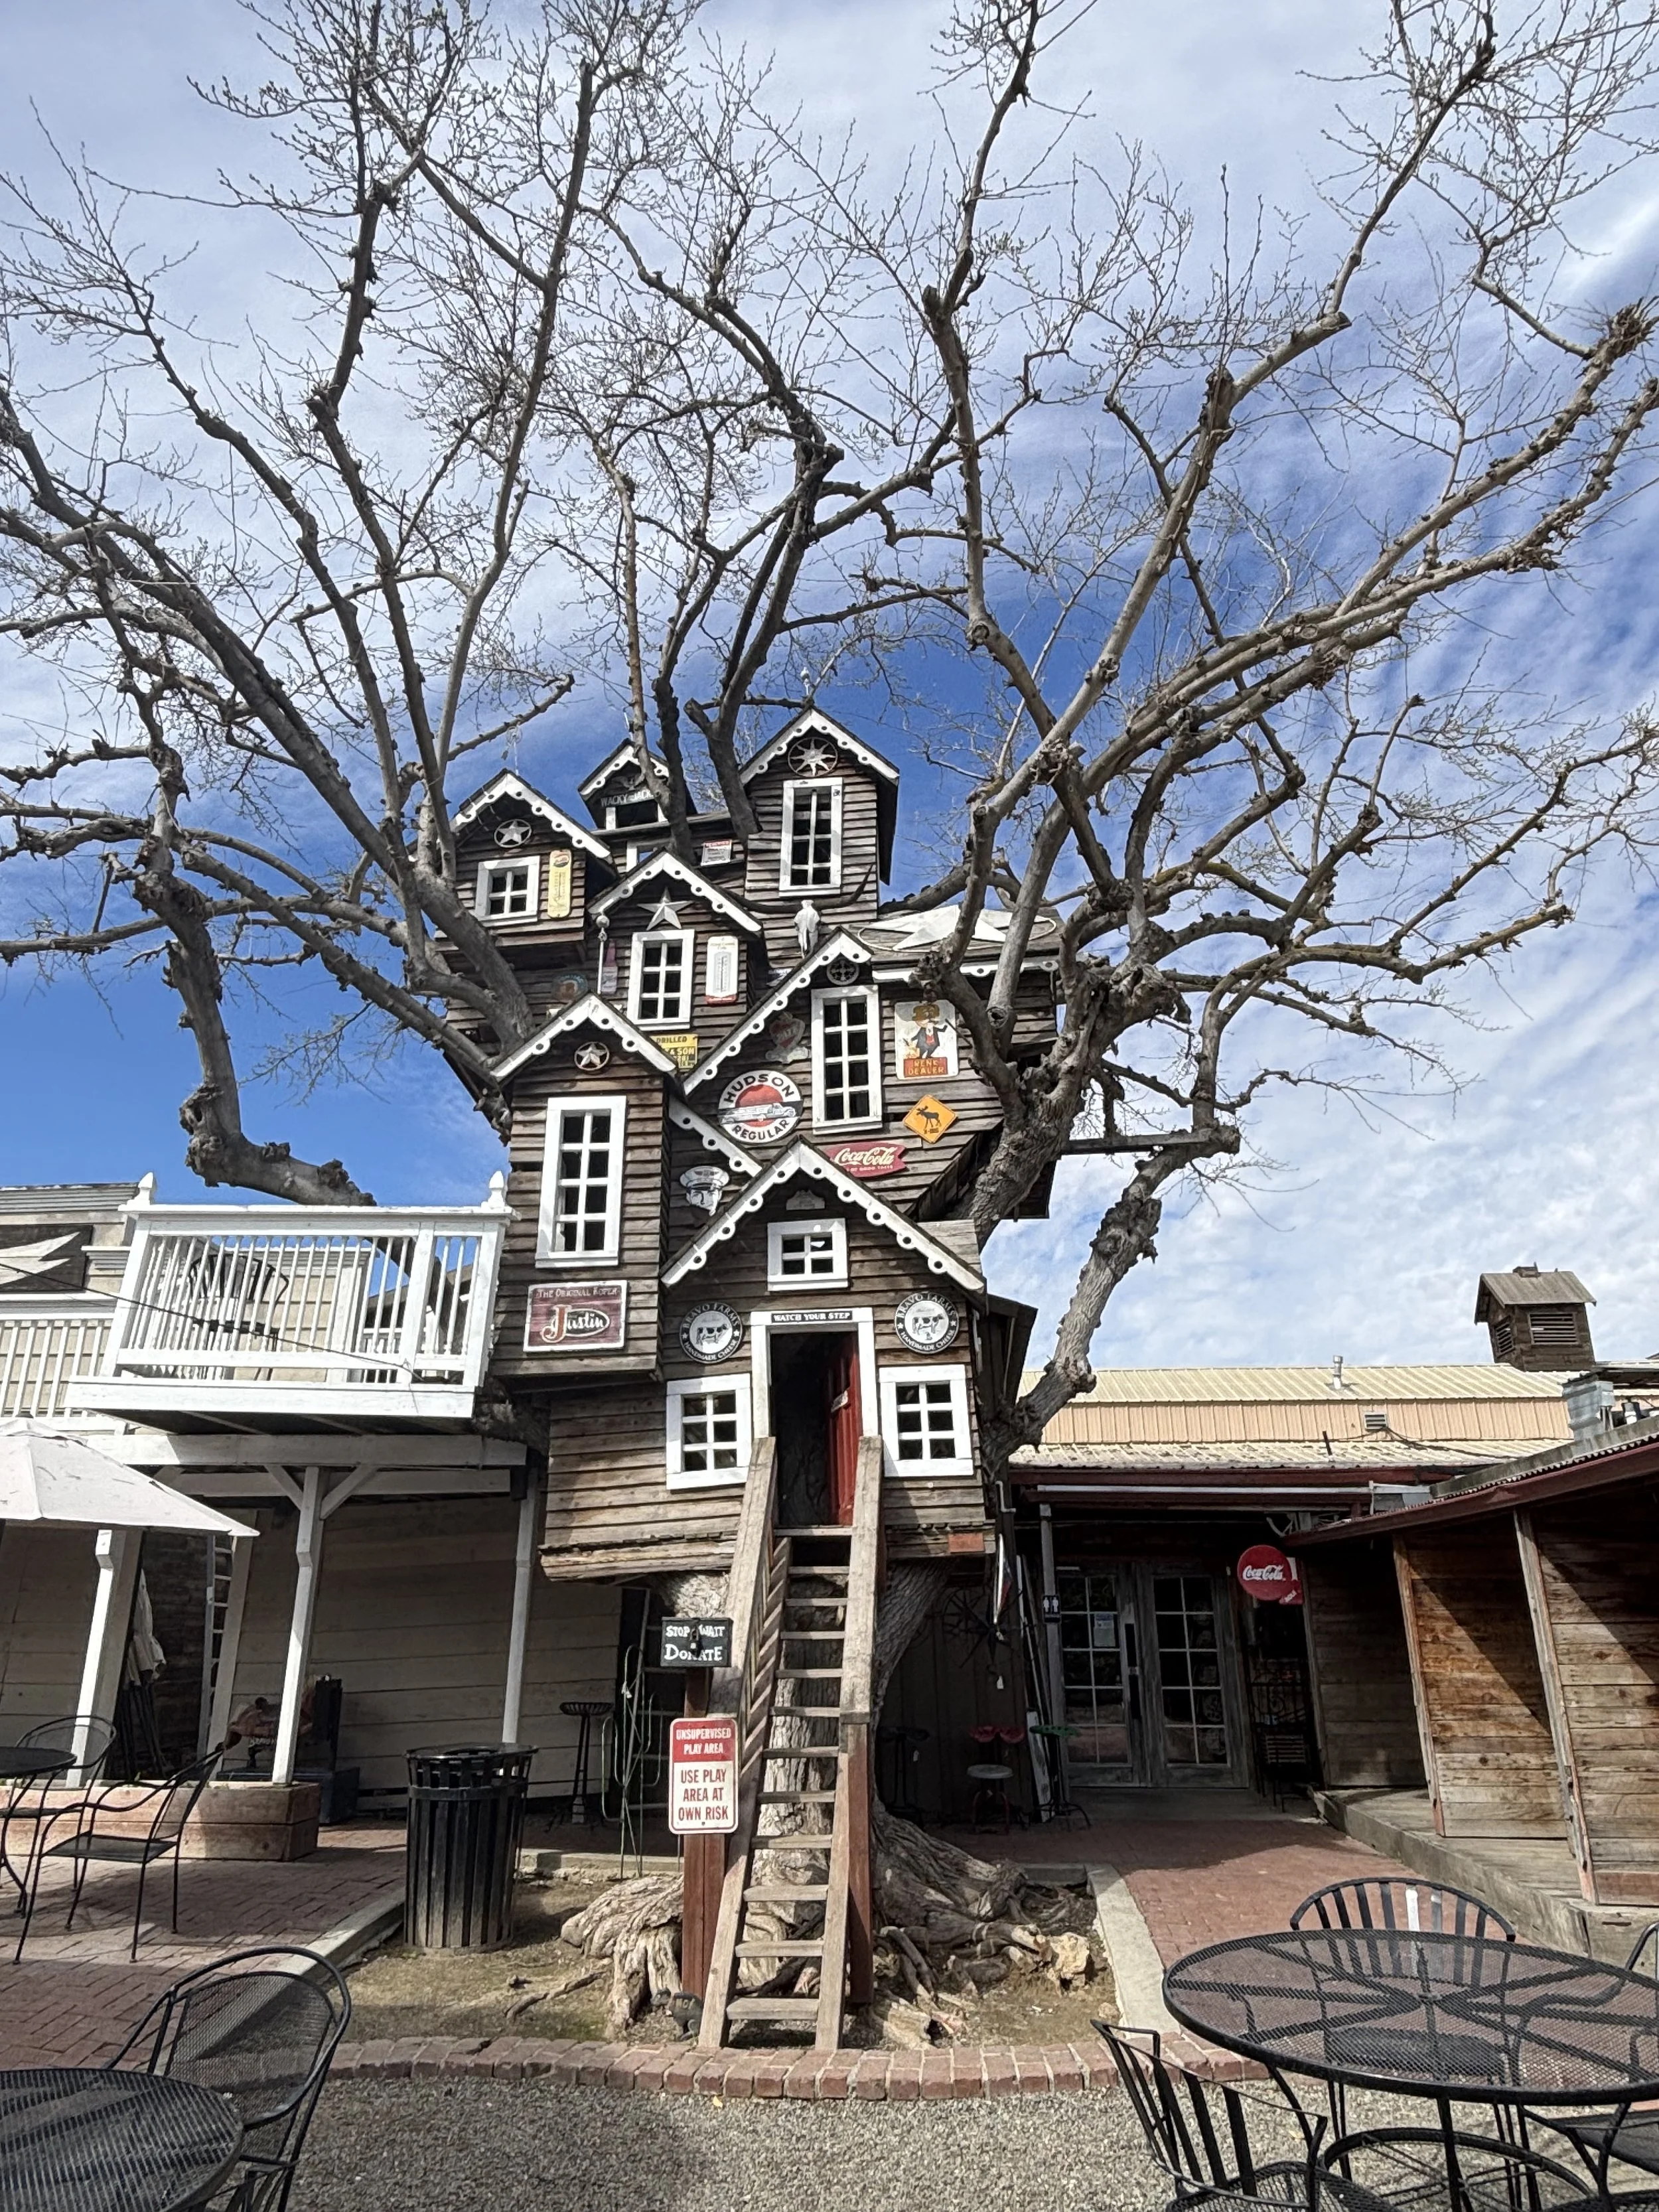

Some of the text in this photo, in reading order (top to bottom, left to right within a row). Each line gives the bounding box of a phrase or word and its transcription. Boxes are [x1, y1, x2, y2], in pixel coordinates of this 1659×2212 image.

[677, 1046, 695, 1056] SON
[908, 1066, 944, 1076] DEALER
[723, 1074, 794, 1103] HUDSON
[732, 1119, 790, 1140] REGULAR
[538, 1289, 554, 1298] THE
[540, 1303, 605, 1344] Justin
[682, 1302, 739, 1329] BRAVO FARMS
[773, 1313, 802, 1322] WATCH
[666, 1623, 726, 1639] STOP WAIT
[676, 1728, 732, 1741] UNSUPERVISED
[684, 1742, 724, 1755] PLAY AREA
[680, 1768, 727, 1784] USE PLAY
[682, 1787, 724, 1803] AREA AT
[678, 1805, 729, 1822] OWN RISK
